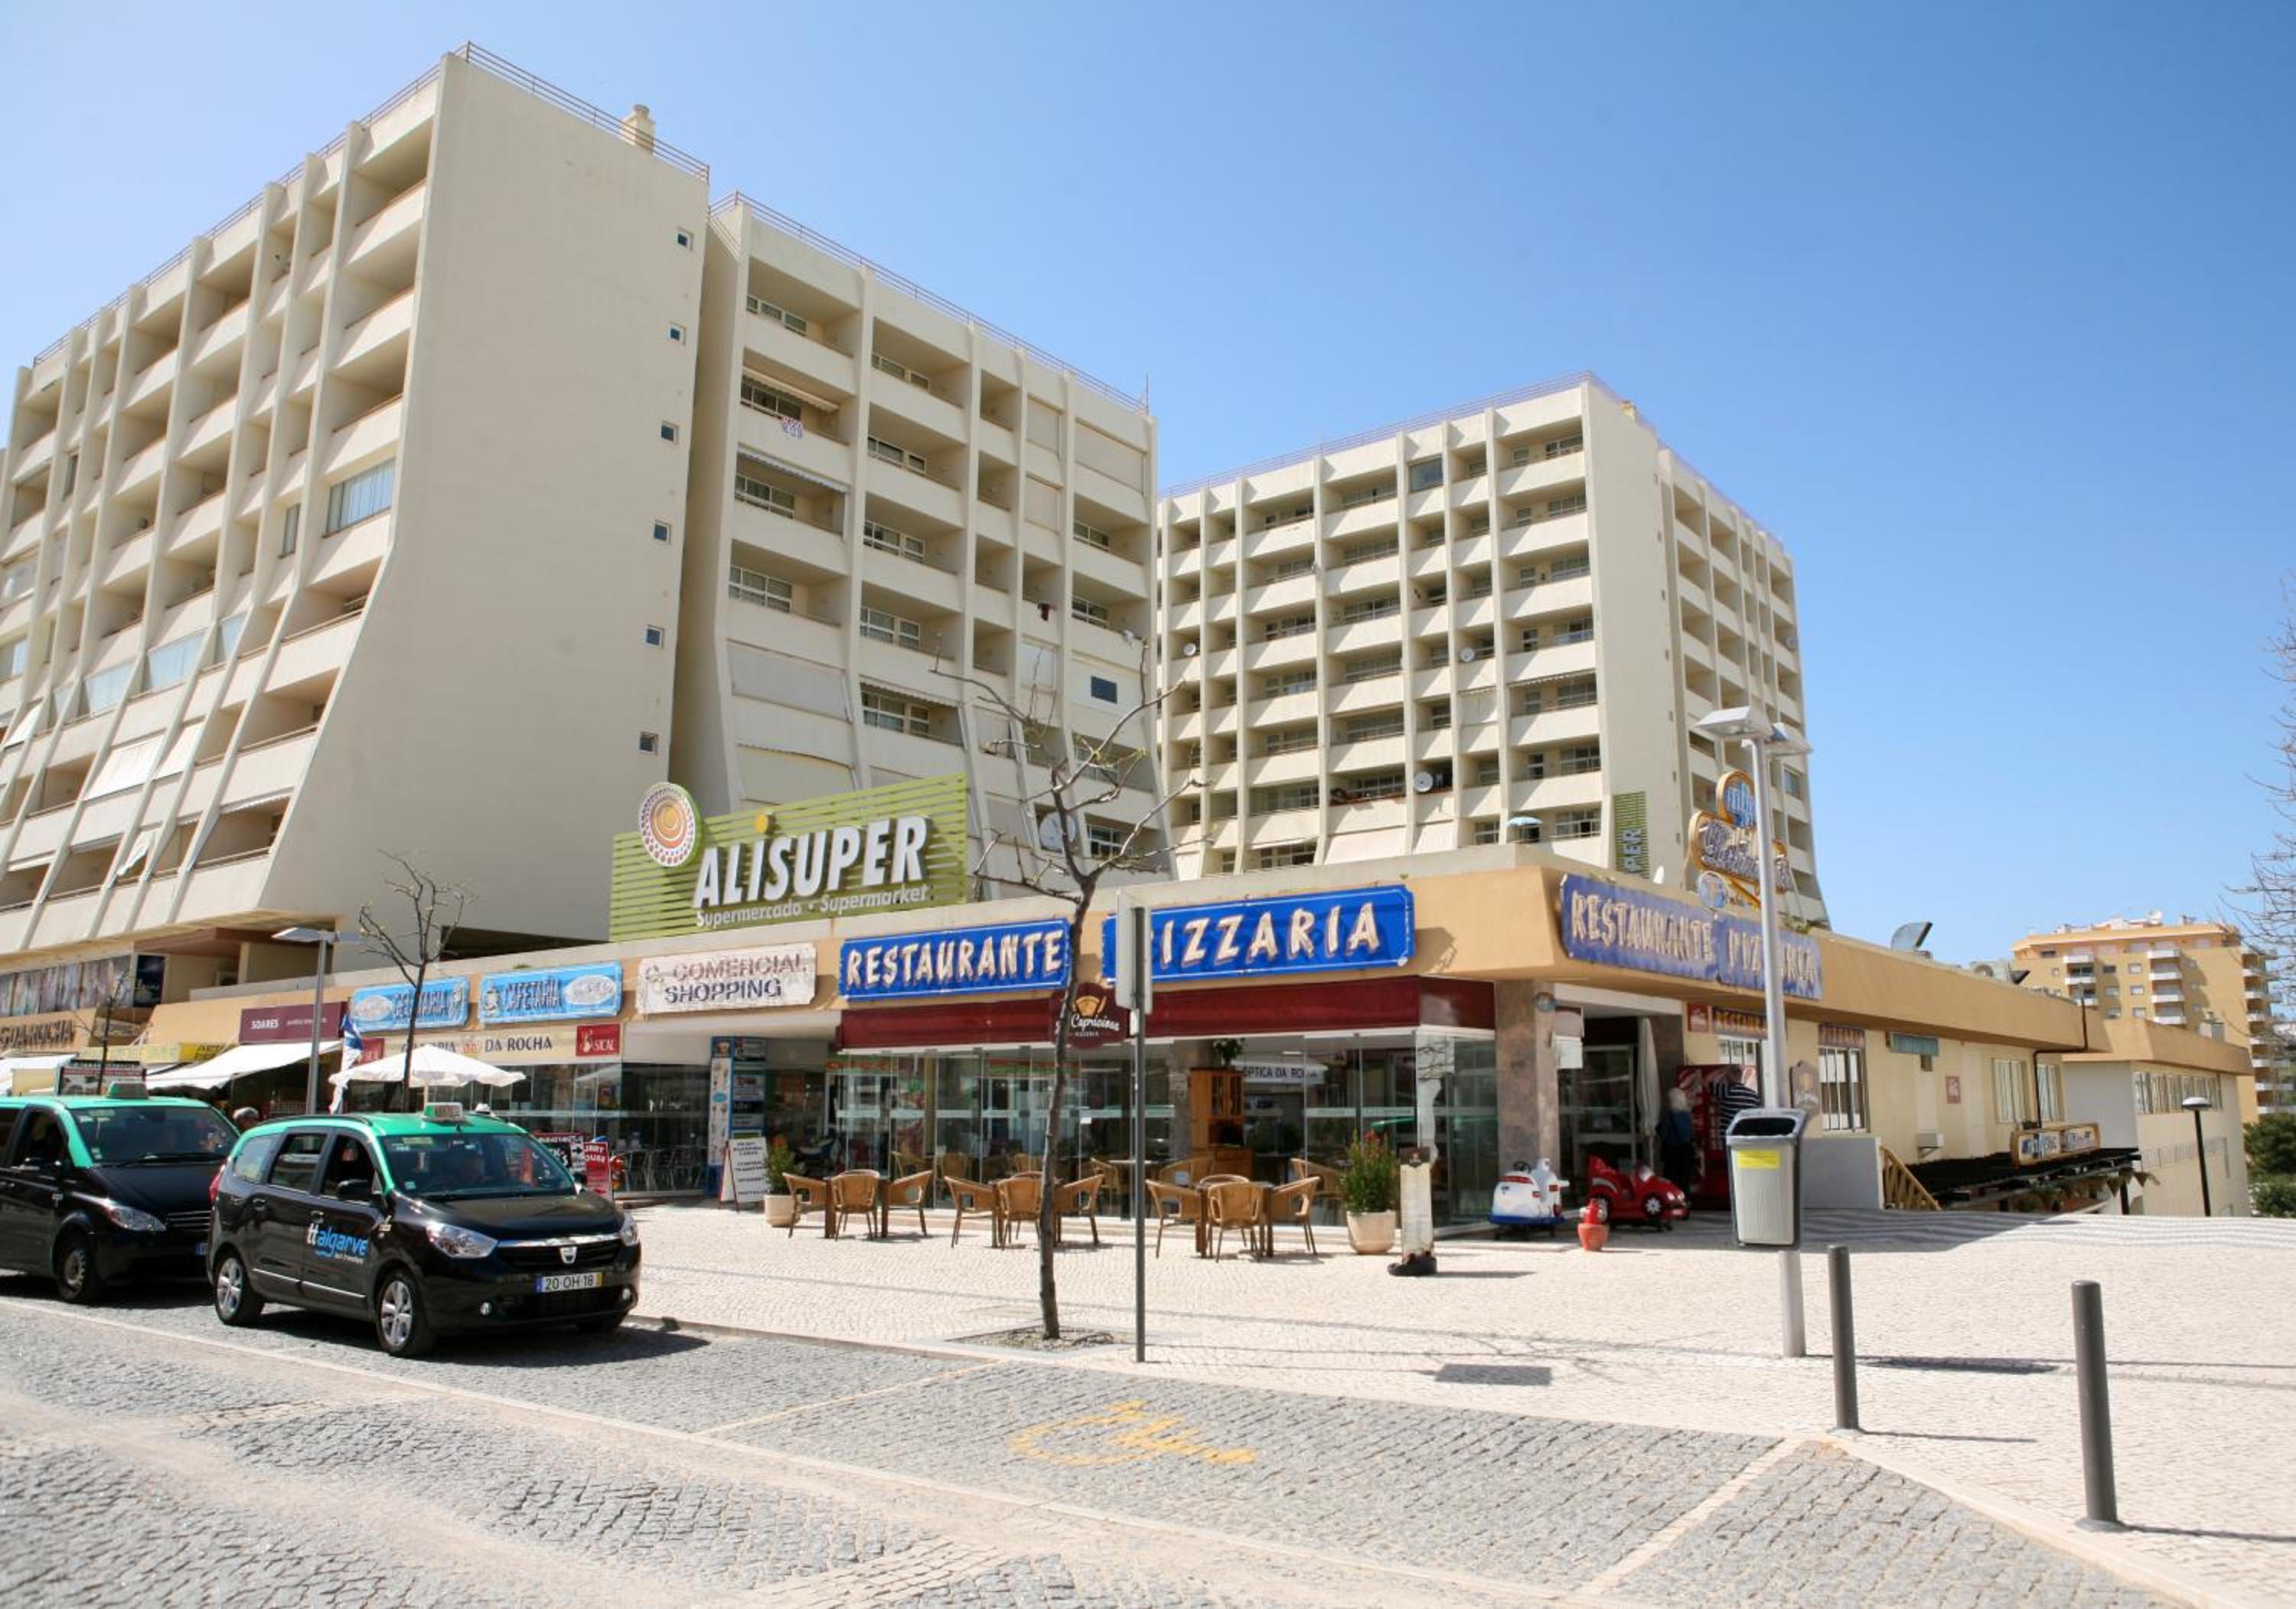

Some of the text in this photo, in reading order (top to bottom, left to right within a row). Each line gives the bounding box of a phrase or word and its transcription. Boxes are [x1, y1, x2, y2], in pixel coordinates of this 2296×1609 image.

[693, 813, 931, 909] ALISUPER
[696, 883, 929, 928] Supermercado Supermarket
[1150, 902, 1381, 971] IZZARIA
[673, 953, 807, 981] COMERCIAL
[846, 929, 1064, 990] RESTAURANTE
[665, 977, 781, 1004] SHOPPING
[251, 1019, 279, 1030] SOARES
[485, 1036, 553, 1053] DA ROCHA
